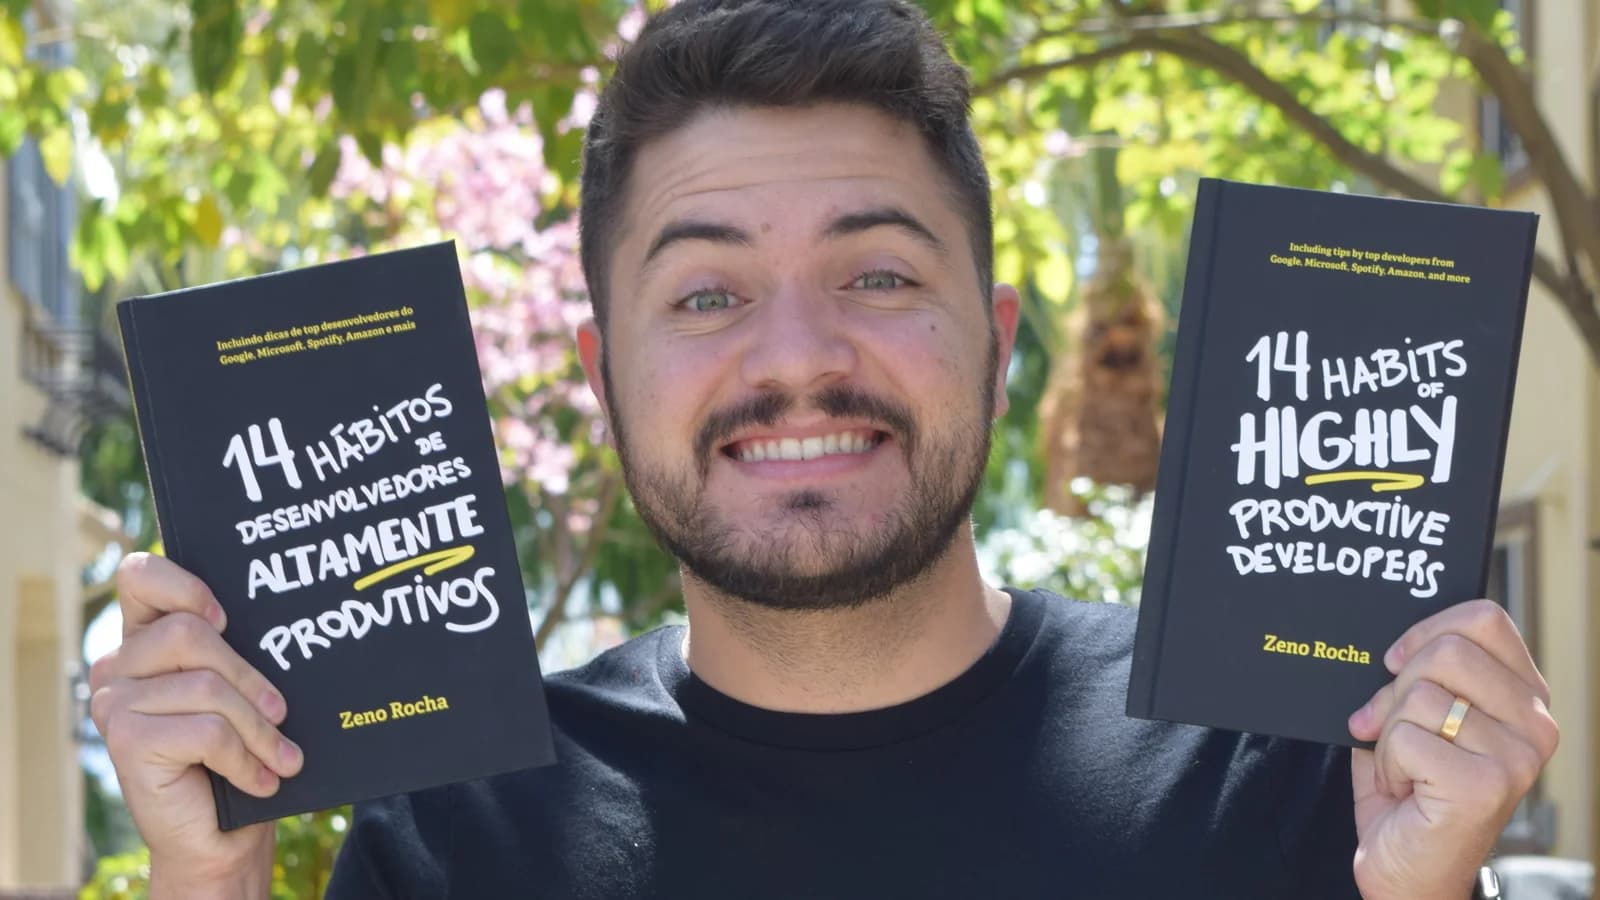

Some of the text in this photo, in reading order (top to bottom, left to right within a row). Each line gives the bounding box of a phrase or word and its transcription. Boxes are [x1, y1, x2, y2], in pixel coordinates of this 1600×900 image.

[1270, 254, 1471, 284] Google, Microsoft, Spotify, Amazon, and more
[1289, 242, 1455, 269] Including tips by top developers from
[216, 305, 414, 351] Incluindo dicas de top desenvolvedores do
[219, 319, 417, 365] Google, Microsoft, Spotify, Amazon e mais
[1245, 330, 1311, 401] 14
[1417, 381, 1444, 399] OF
[222, 416, 302, 502] 14
[414, 431, 447, 456] DE
[1230, 395, 1458, 489] HIGHLY
[235, 456, 472, 545] DESENVOLVEDORES
[247, 494, 484, 599] ALTAMENTE
[1226, 541, 1445, 598] DEVELOPERS
[1263, 633, 1371, 665] Zeno Rocha
[339, 694, 449, 730] Zeno Rocha
